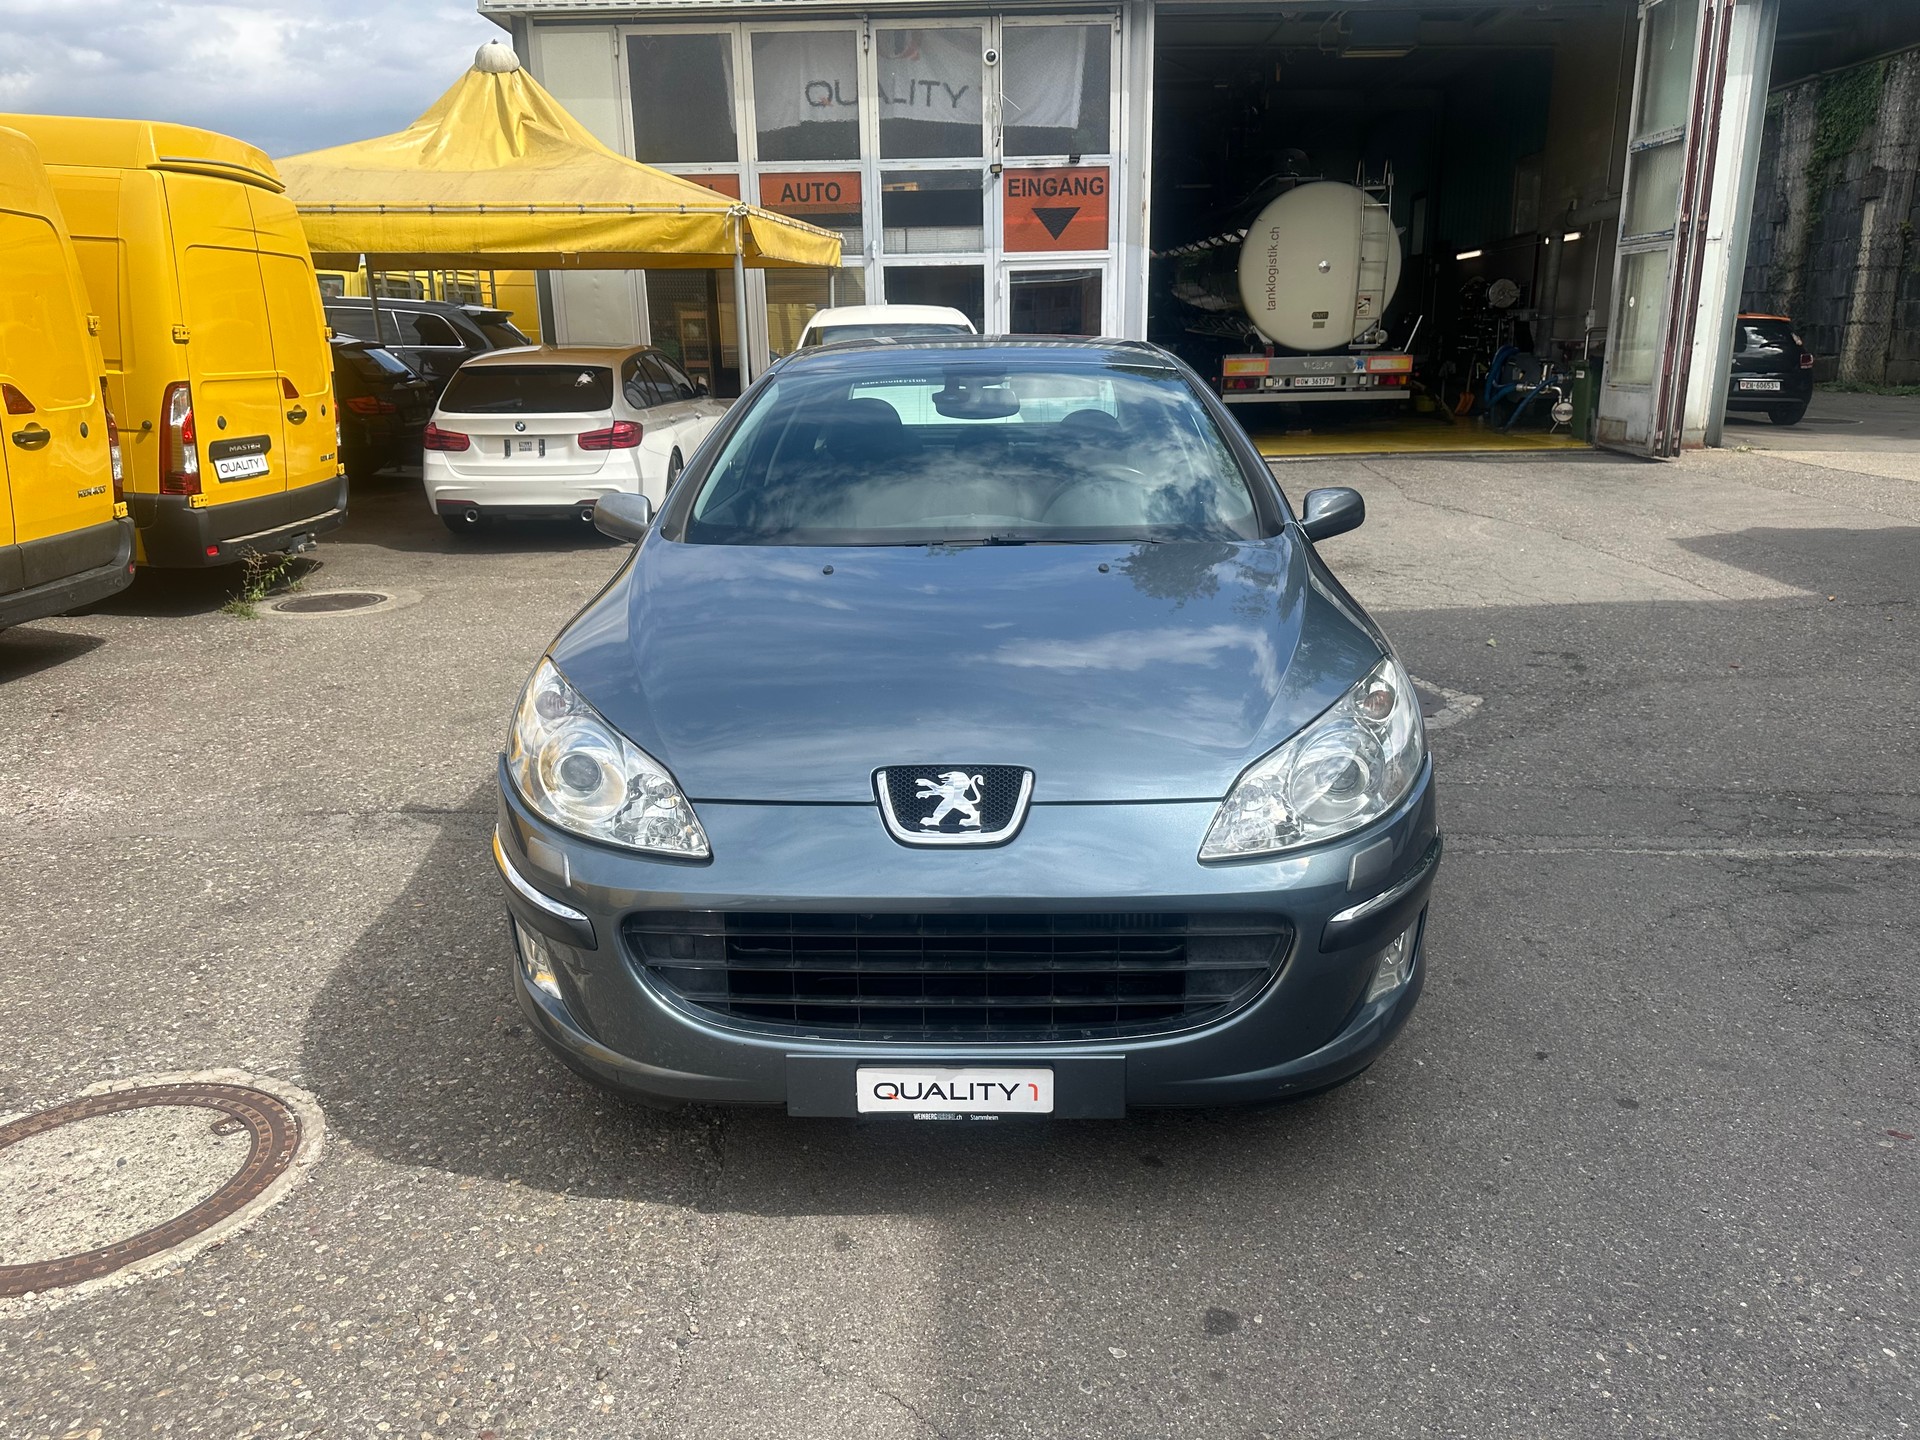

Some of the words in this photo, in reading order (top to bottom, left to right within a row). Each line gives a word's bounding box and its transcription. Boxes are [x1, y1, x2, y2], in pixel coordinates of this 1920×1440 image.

[780, 182, 841, 203] AUTO
[1007, 177, 1104, 197] EINGANG
[1265, 226, 1280, 311] tanklogistik.ch
[229, 443, 261, 453] MASTER
[220, 458, 259, 473] QUALITY
[874, 1082, 1020, 1101] QUALITY
[1028, 1083, 1039, 1102] 1
